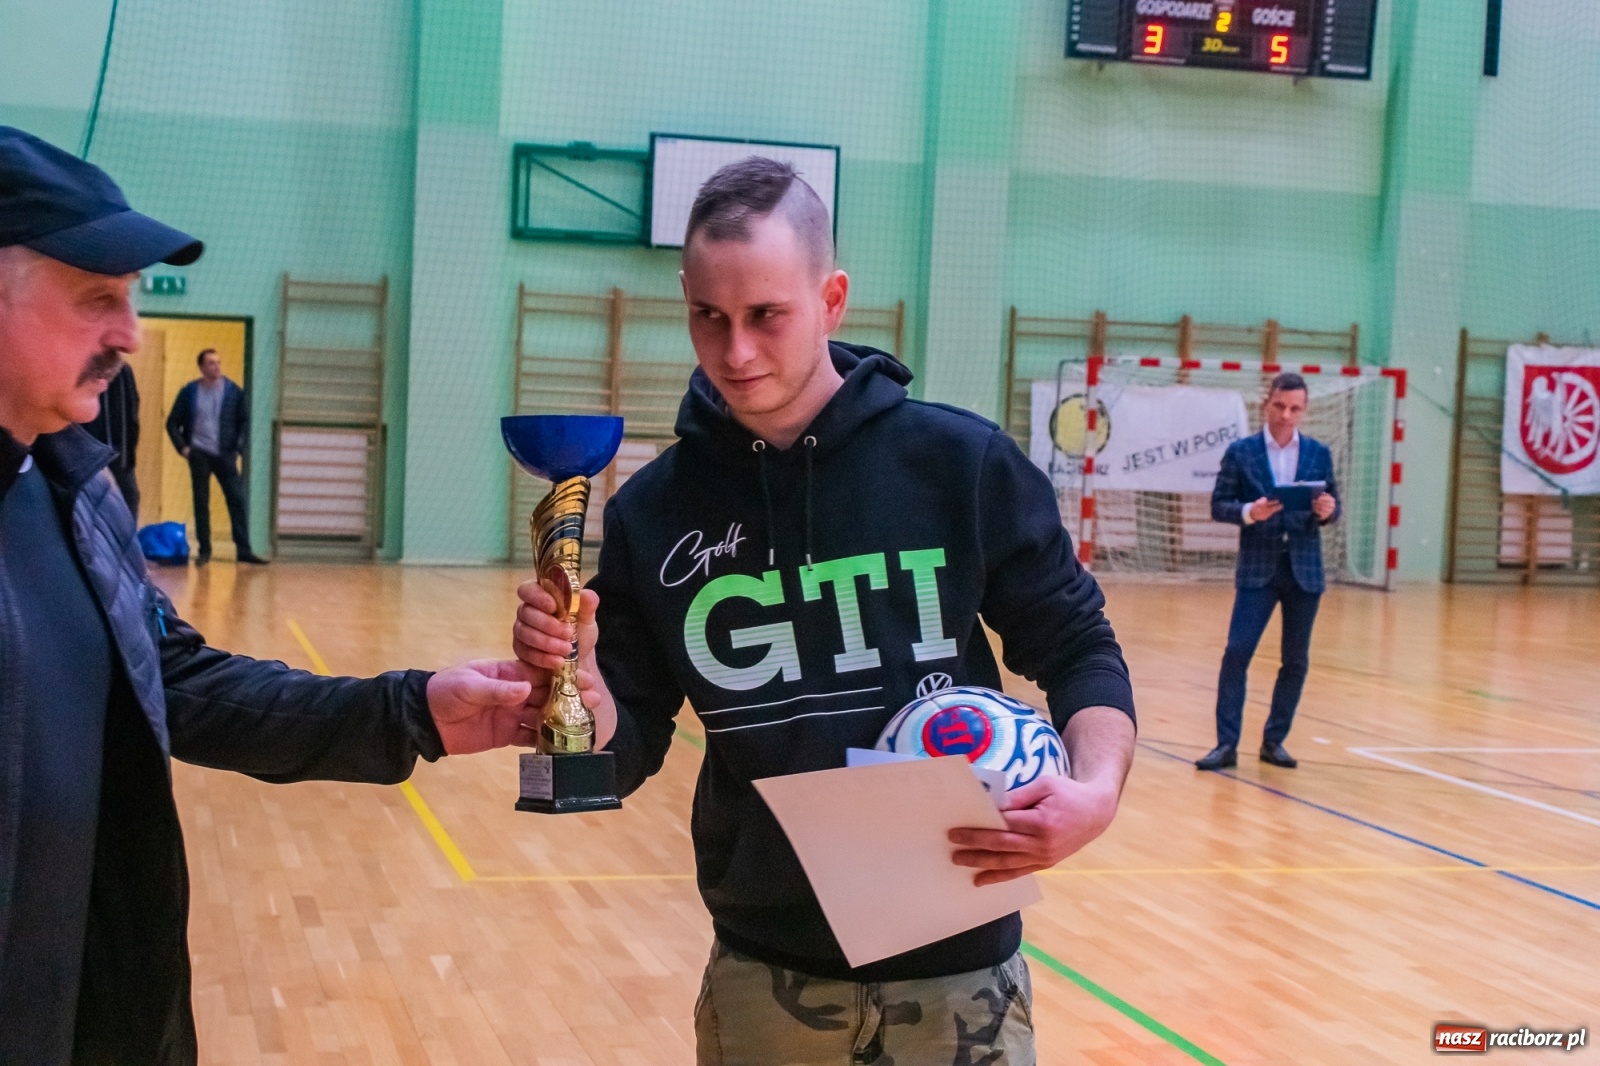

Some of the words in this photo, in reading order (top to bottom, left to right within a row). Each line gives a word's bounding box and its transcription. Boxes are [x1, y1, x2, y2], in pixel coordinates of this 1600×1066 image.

[1136, 0, 1212, 20] GOSPODARZE
[1216, 12, 1232, 33] 2
[1252, 5, 1296, 27] GOŚCIE
[1144, 24, 1164, 54] 3
[1270, 35, 1288, 63] 5
[1122, 445, 1165, 471] JEST
[1171, 439, 1189, 456] W
[660, 522, 747, 587] Golf
[684, 548, 958, 691] GTI
